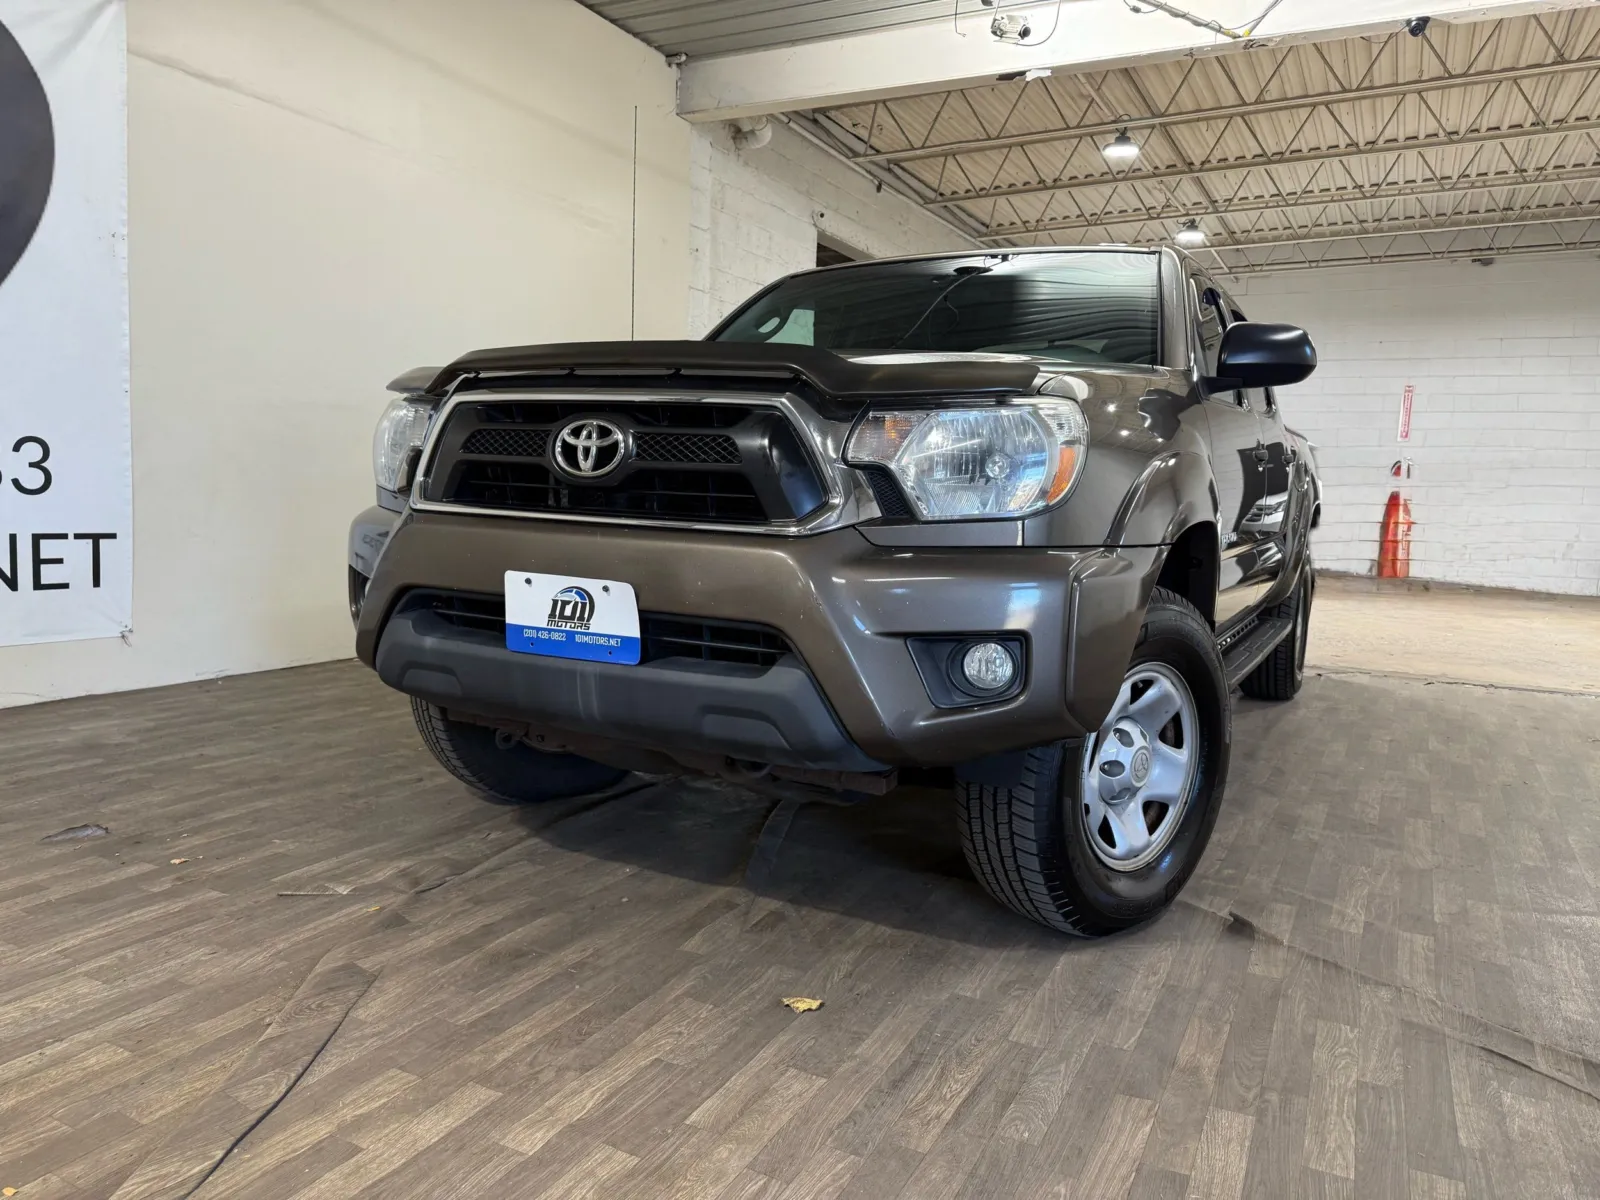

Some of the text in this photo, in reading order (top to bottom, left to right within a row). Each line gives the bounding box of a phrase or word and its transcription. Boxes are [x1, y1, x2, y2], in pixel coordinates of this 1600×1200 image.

[0, 436, 52, 495] 3
[547, 620, 591, 631] MOTORS
[523, 629, 621, 647] (201) 426-0822 101MOTORS.NET
